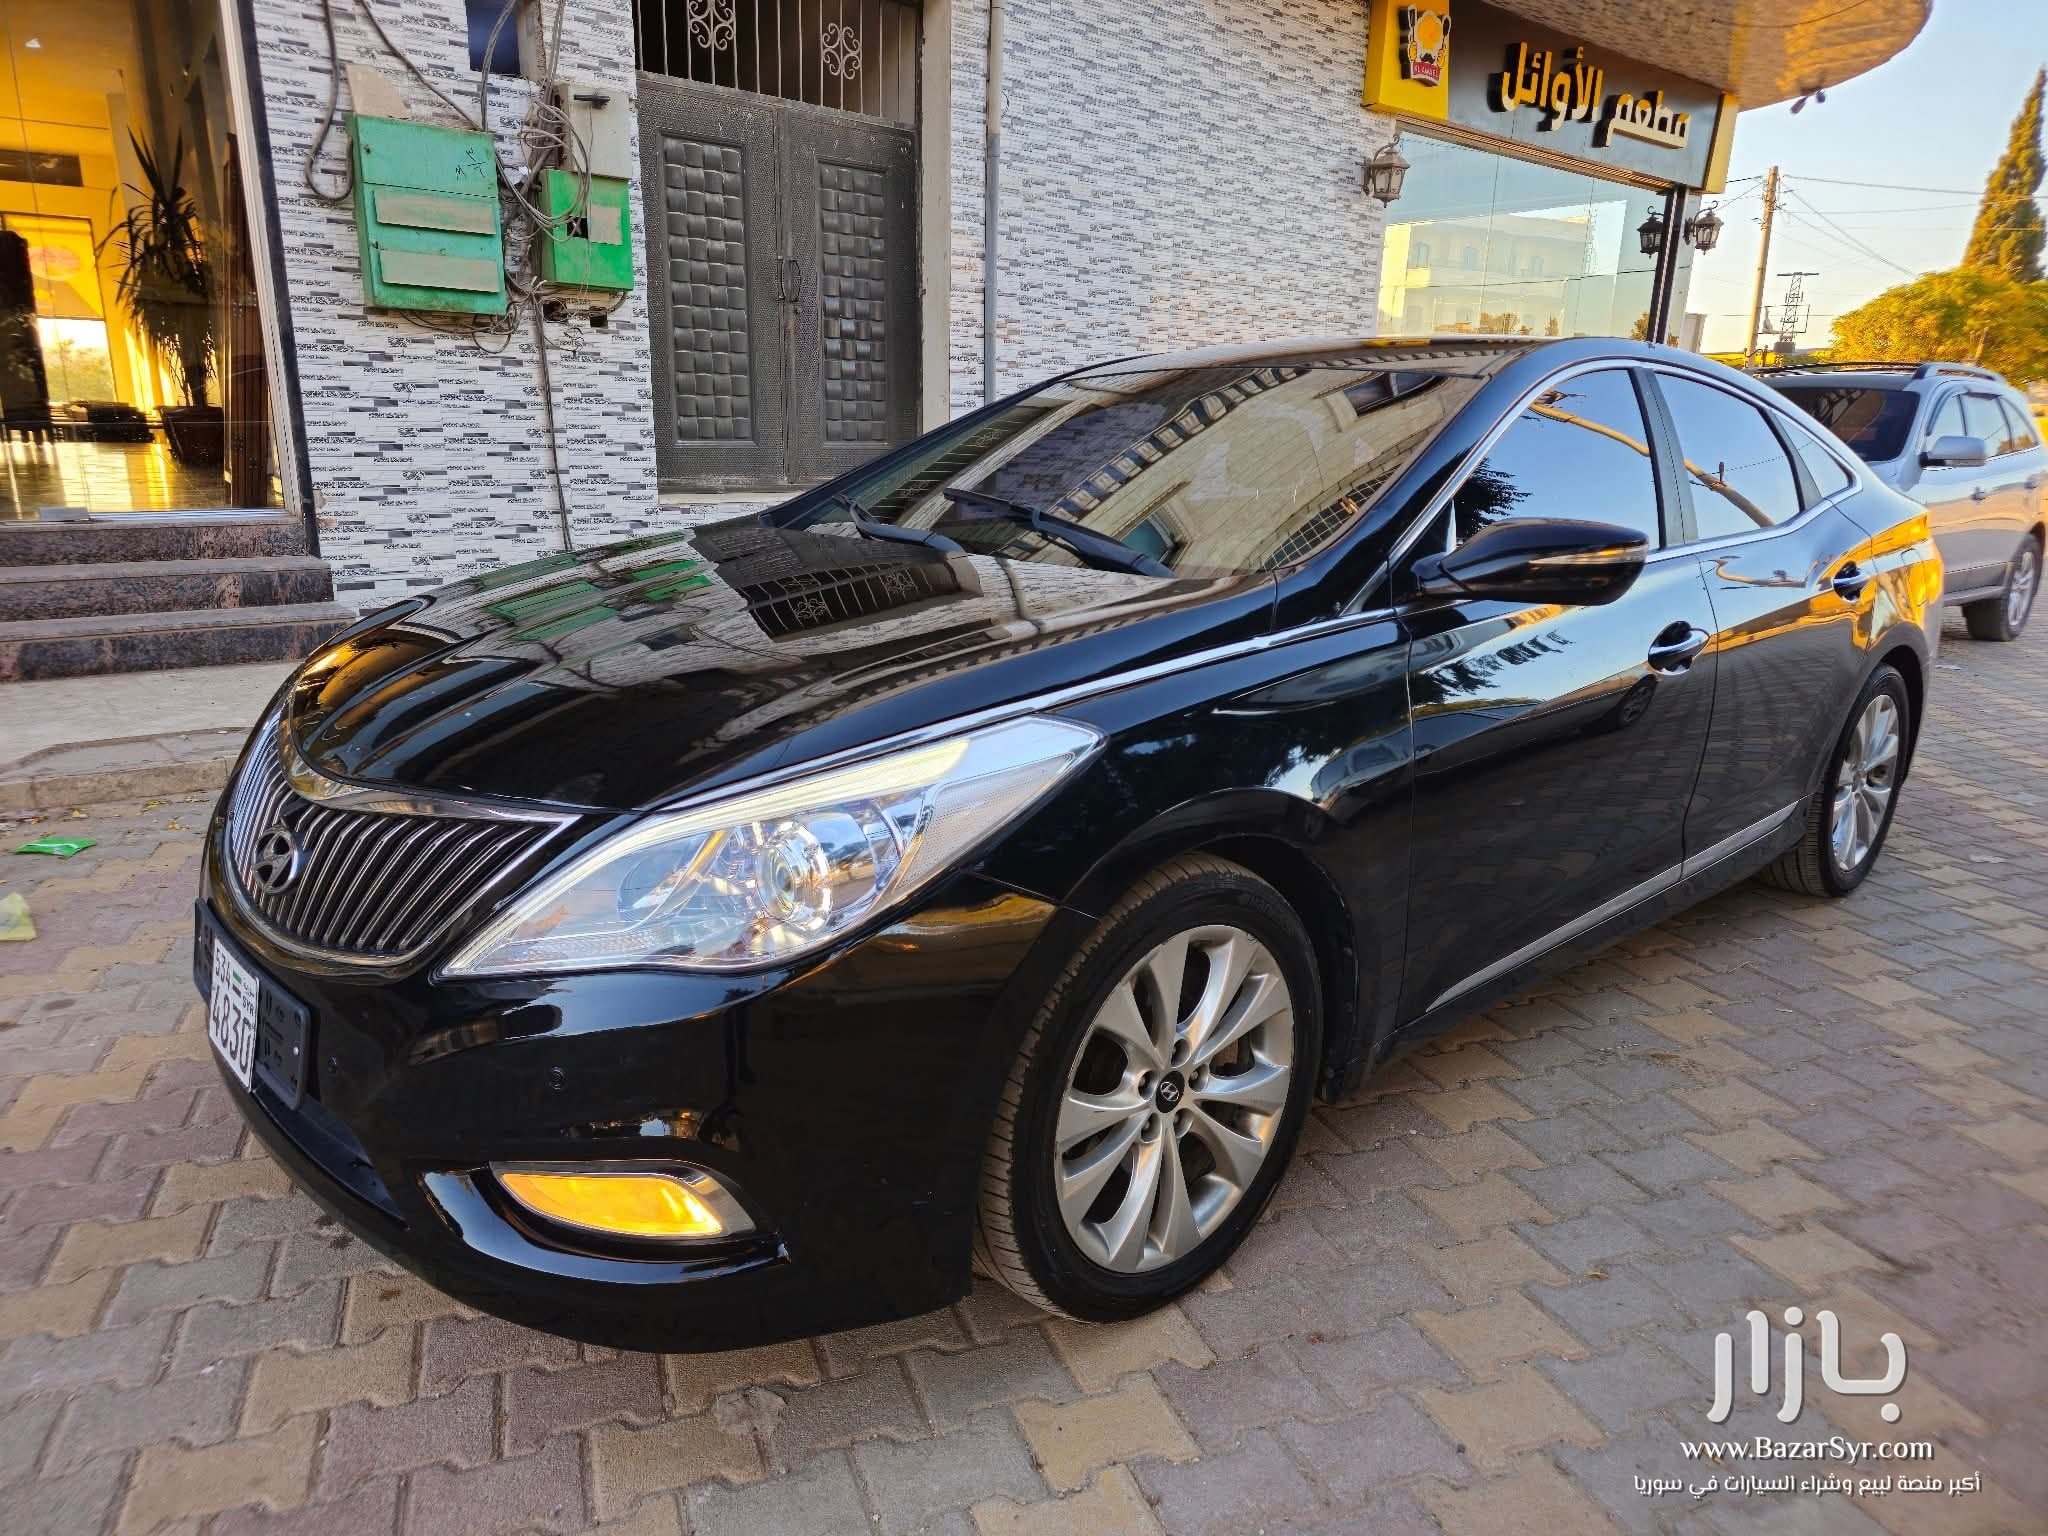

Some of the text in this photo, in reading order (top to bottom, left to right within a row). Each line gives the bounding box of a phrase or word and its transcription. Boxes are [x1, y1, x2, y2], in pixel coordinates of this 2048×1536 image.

[1502, 40, 1691, 148] مطعم الأوائل
[215, 946, 231, 991] 534
[212, 984, 252, 1075] 4830
[242, 995, 254, 1017] SYR
